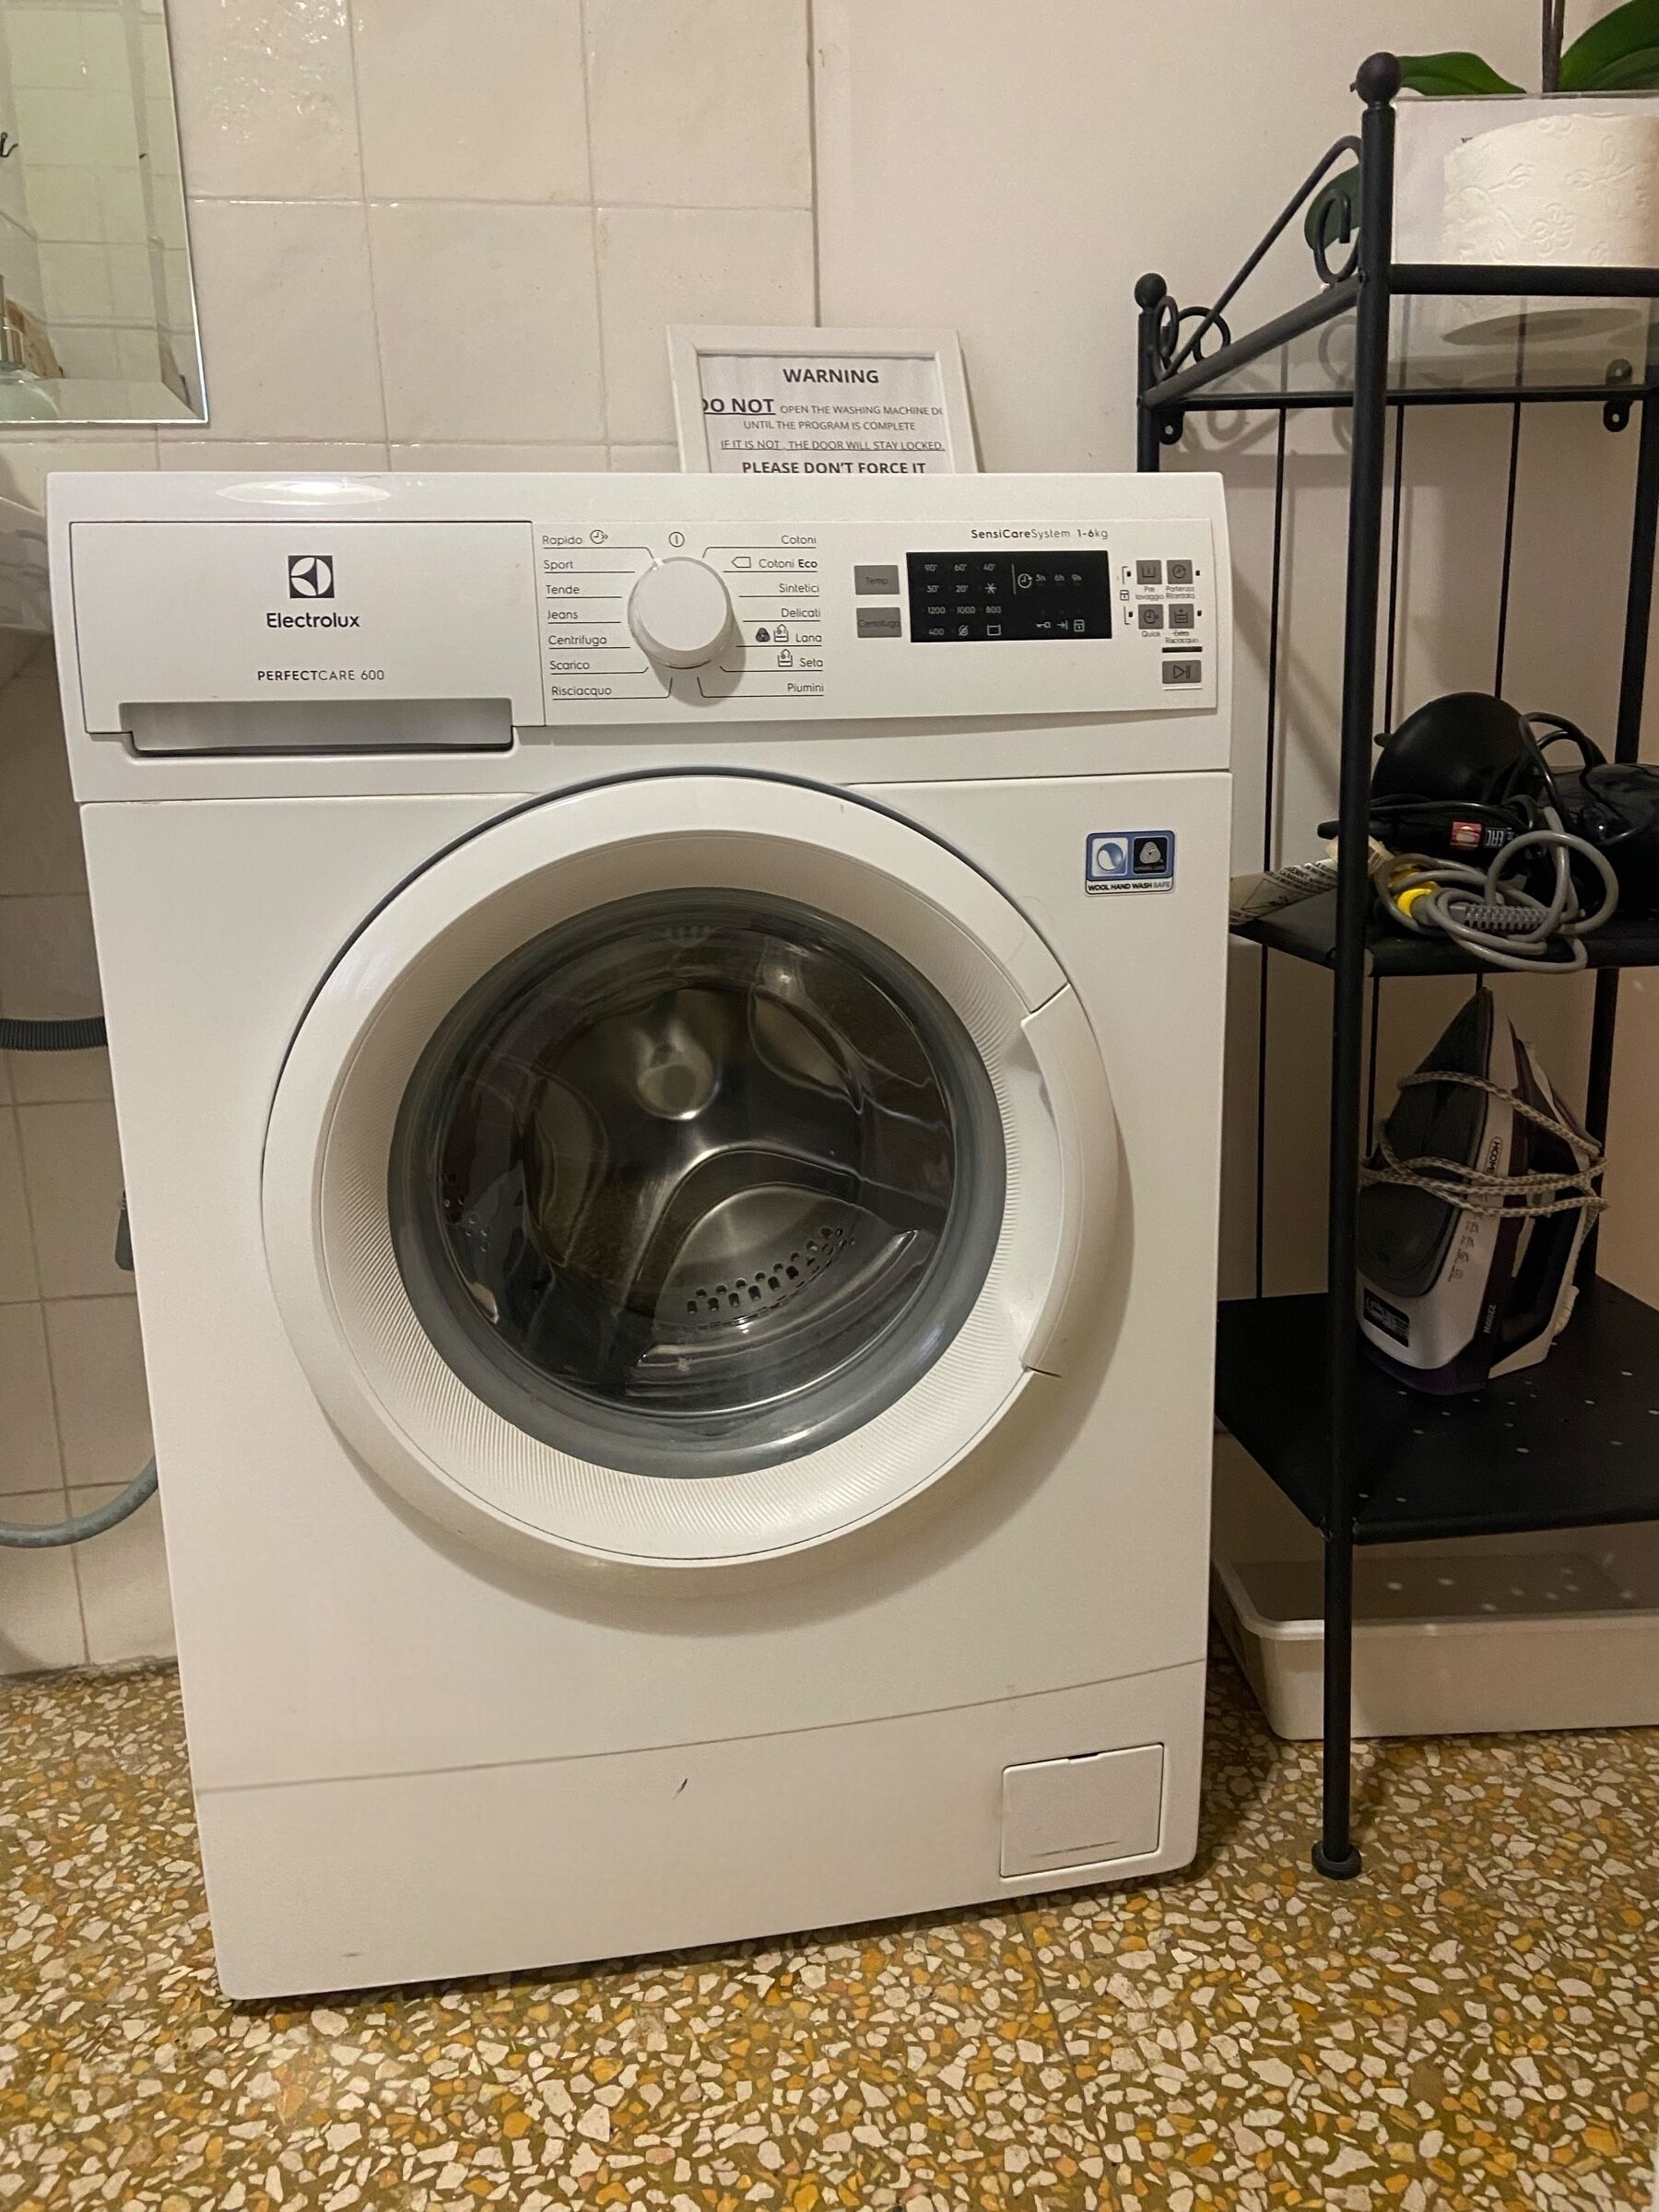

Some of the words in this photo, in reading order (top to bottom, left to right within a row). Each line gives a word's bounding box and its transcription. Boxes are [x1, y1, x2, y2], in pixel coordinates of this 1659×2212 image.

[782, 369, 879, 383] WARNING
[732, 398, 775, 413] NOT
[780, 405, 809, 414] OPEN
[812, 406, 830, 414] THE
[832, 406, 881, 415] WASHING
[883, 406, 929, 416] MACHINE
[744, 420, 774, 429] UNTIL
[776, 421, 795, 429] THE
[798, 421, 849, 430] PROGRAM
[852, 422, 861, 430] IS
[864, 421, 916, 430] COMPLETE
[721, 440, 730, 449] IF
[733, 441, 741, 449] IT
[745, 441, 754, 449] IS
[788, 441, 808, 450] THE
[812, 441, 843, 450] DOOR
[845, 441, 870, 450] WILL
[873, 441, 899, 450] STAY
[742, 462, 799, 473] PLEASE
[805, 463, 853, 473] DON'T
[859, 463, 907, 474] FORCE
[912, 463, 926, 474] IT
[781, 535, 817, 545] Cotoni
[971, 529, 1071, 540] SensiCareSystem
[1077, 529, 1109, 540] 1-6kg
[542, 535, 583, 547] Rapido
[544, 559, 573, 571] Sport
[759, 559, 794, 569] Cotoni
[798, 559, 818, 569] Eco
[546, 585, 580, 595] Tende
[779, 582, 819, 593] Sintetici
[547, 609, 579, 620] Jeans
[781, 608, 821, 618] Delicati
[927, 606, 947, 615] 1200
[957, 606, 976, 615] 1000
[266, 612, 360, 628] Electrolux
[548, 635, 606, 647] Centrifuga
[795, 633, 822, 643] Lana
[550, 660, 590, 671] Scarico
[799, 657, 823, 667] Seta
[257, 670, 355, 681] PERFECTCARE
[360, 669, 385, 680] 600
[551, 686, 612, 698] Risciacquo
[787, 682, 825, 693] Piumini
